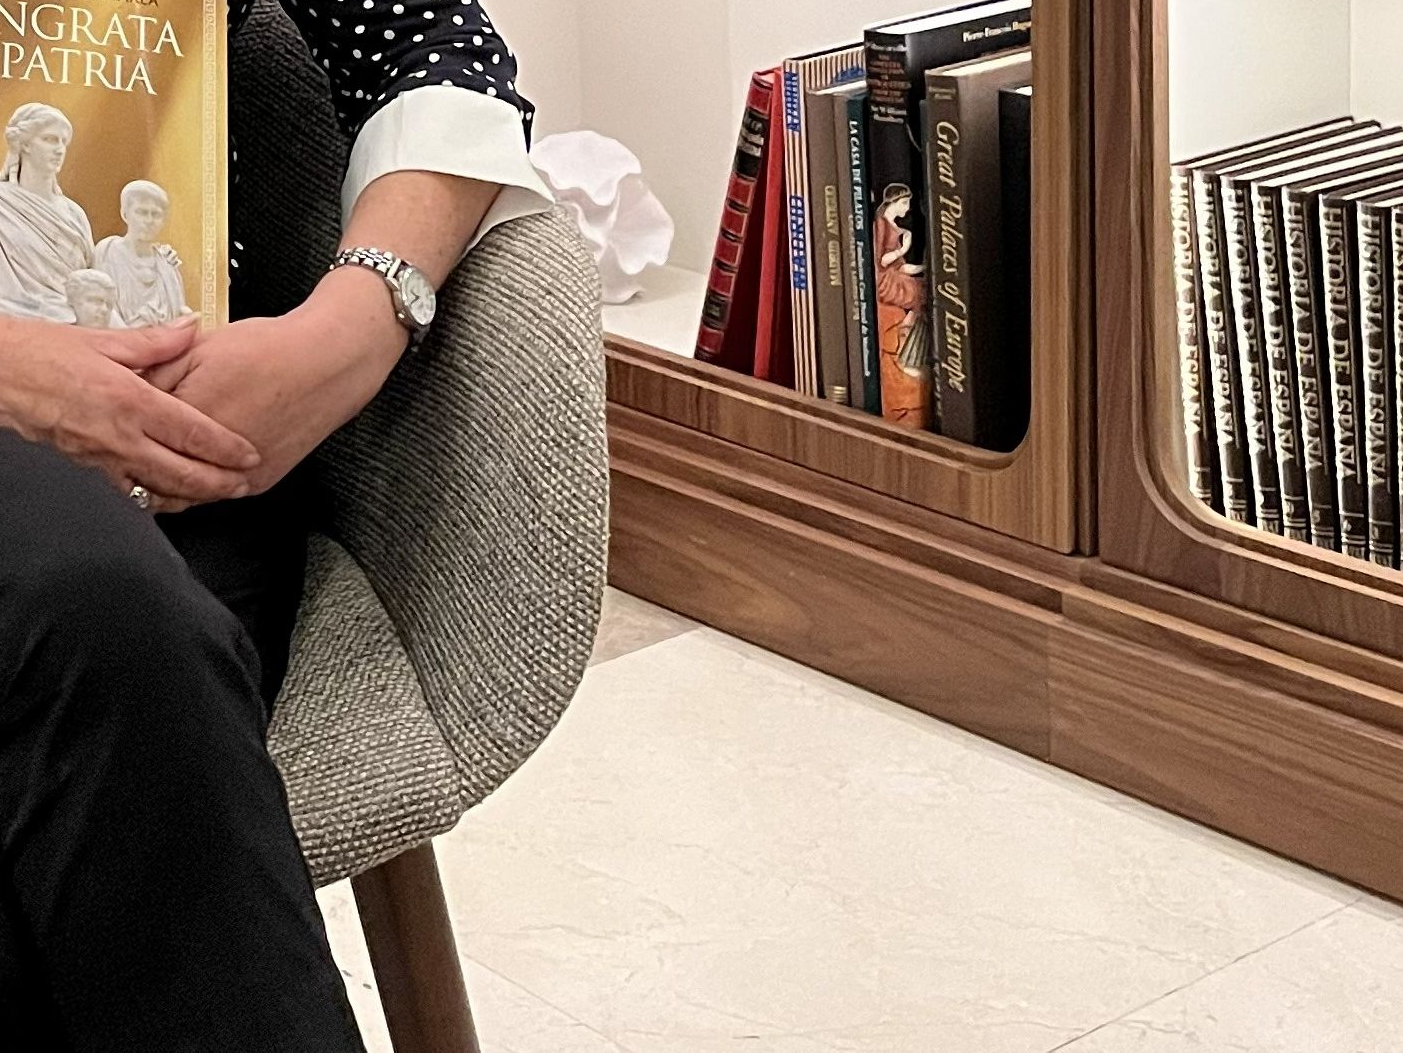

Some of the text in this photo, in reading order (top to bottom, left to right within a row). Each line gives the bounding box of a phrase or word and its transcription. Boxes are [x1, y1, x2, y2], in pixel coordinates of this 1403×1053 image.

[1, 41, 158, 96] PATRIA
[848, 120, 858, 137] LA
[849, 137, 860, 165] CASA
[936, 121, 960, 188] Great
[852, 168, 863, 185] DE
[940, 195, 964, 275] Palaces
[937, 282, 967, 315] of
[1170, 176, 1201, 436] HISTORIA DE ESPAÑA
[1198, 182, 1235, 447] HISTORIA DE ESPAÑA
[1229, 188, 1265, 455] HISTORIA DE ESPAÑA
[1256, 195, 1294, 462] HISTORIA DE ESPAÑA
[1288, 201, 1323, 473] HISTORIA DE ESPAÑA
[941, 310, 969, 393] Europe
[1324, 207, 1357, 481] HISTORIA DE ESPAÑA
[1362, 214, 1387, 487] HISTORIA DE ESPAÑA
